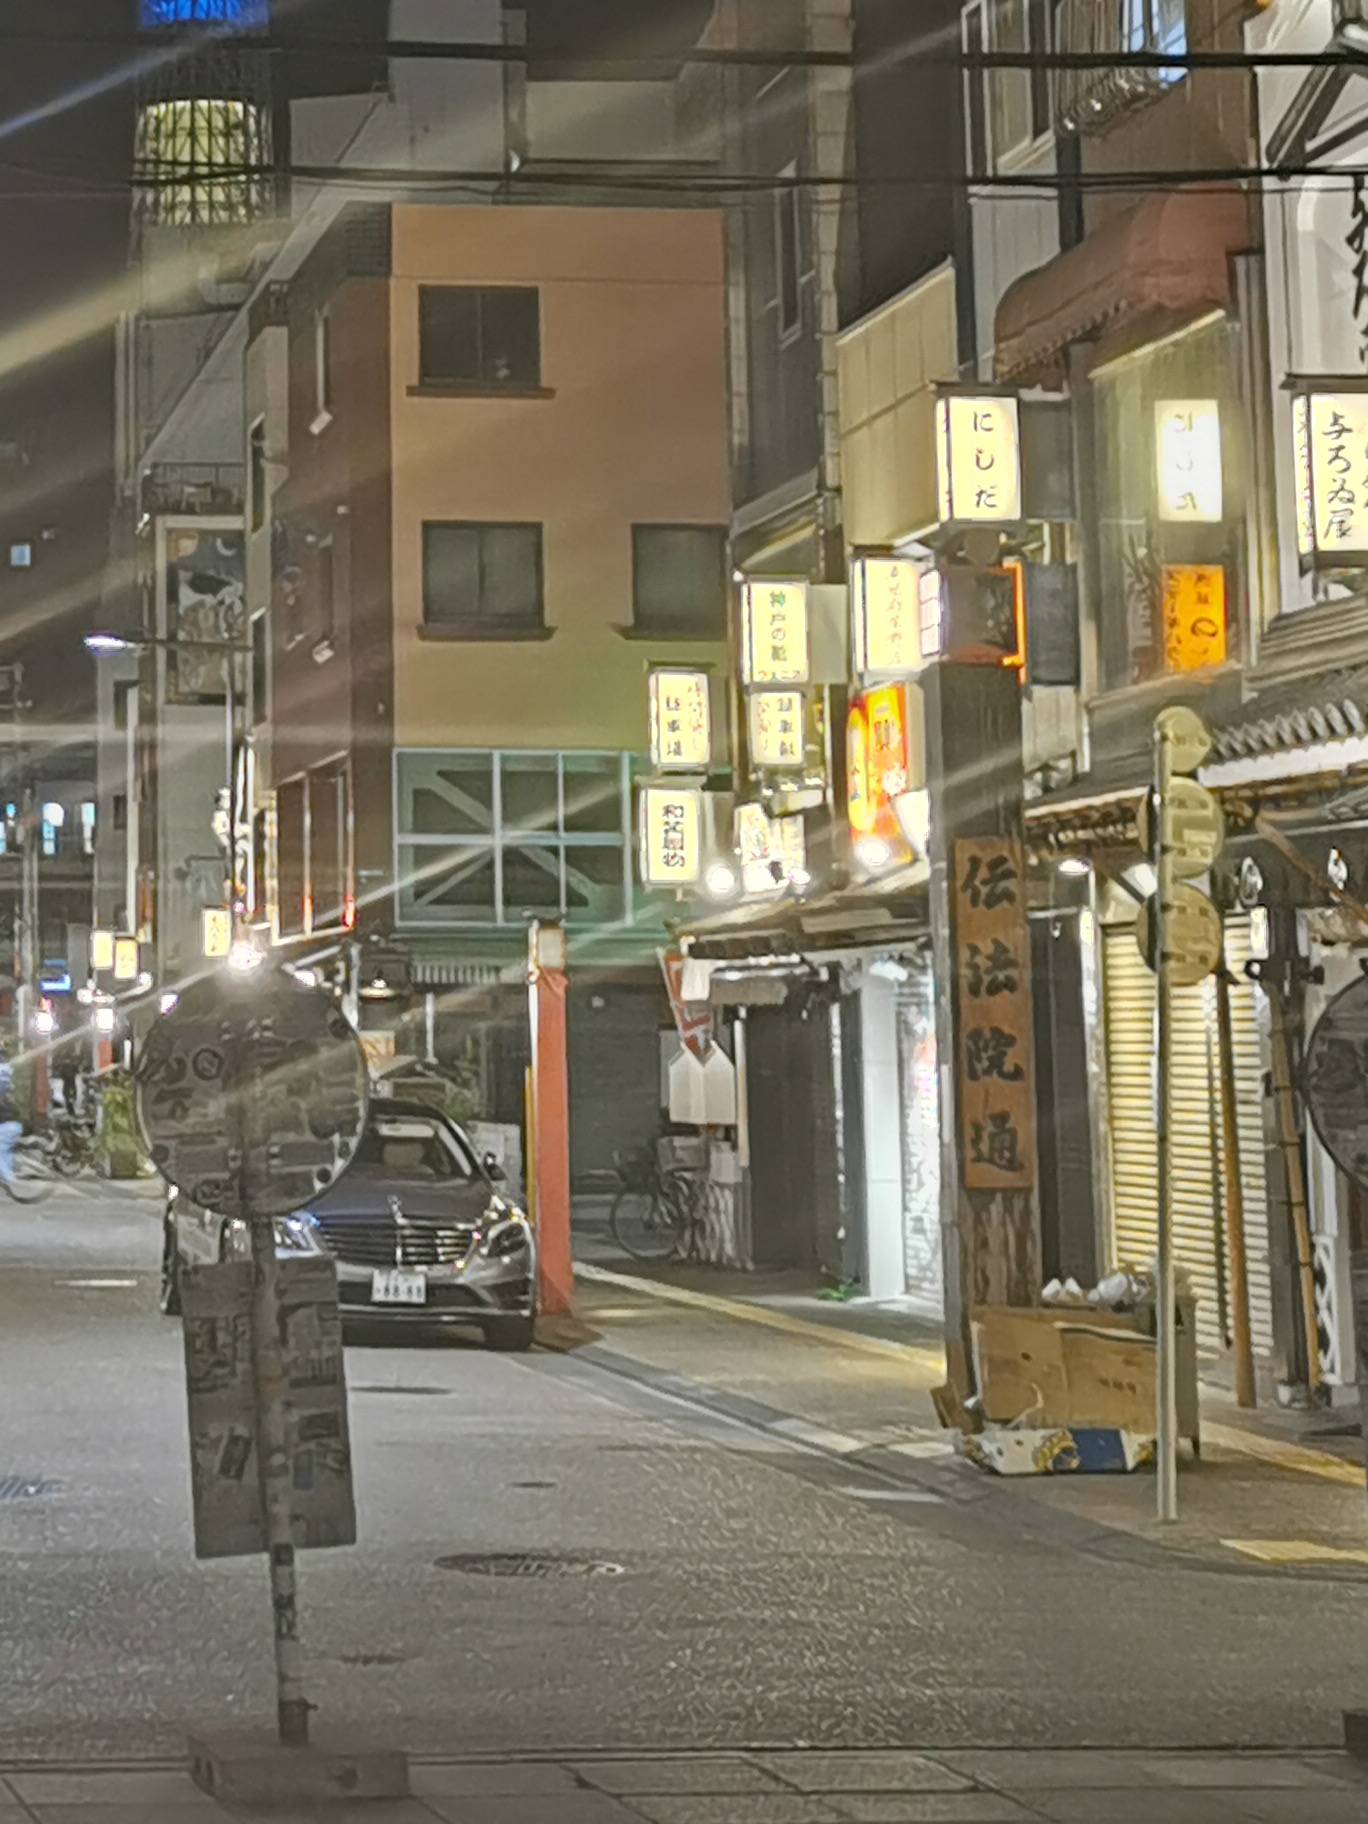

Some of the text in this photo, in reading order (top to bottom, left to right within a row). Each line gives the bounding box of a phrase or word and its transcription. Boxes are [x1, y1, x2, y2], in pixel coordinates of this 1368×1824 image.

[973, 410, 998, 509] にしだ
[961, 855, 1025, 1173] 伝法院通
